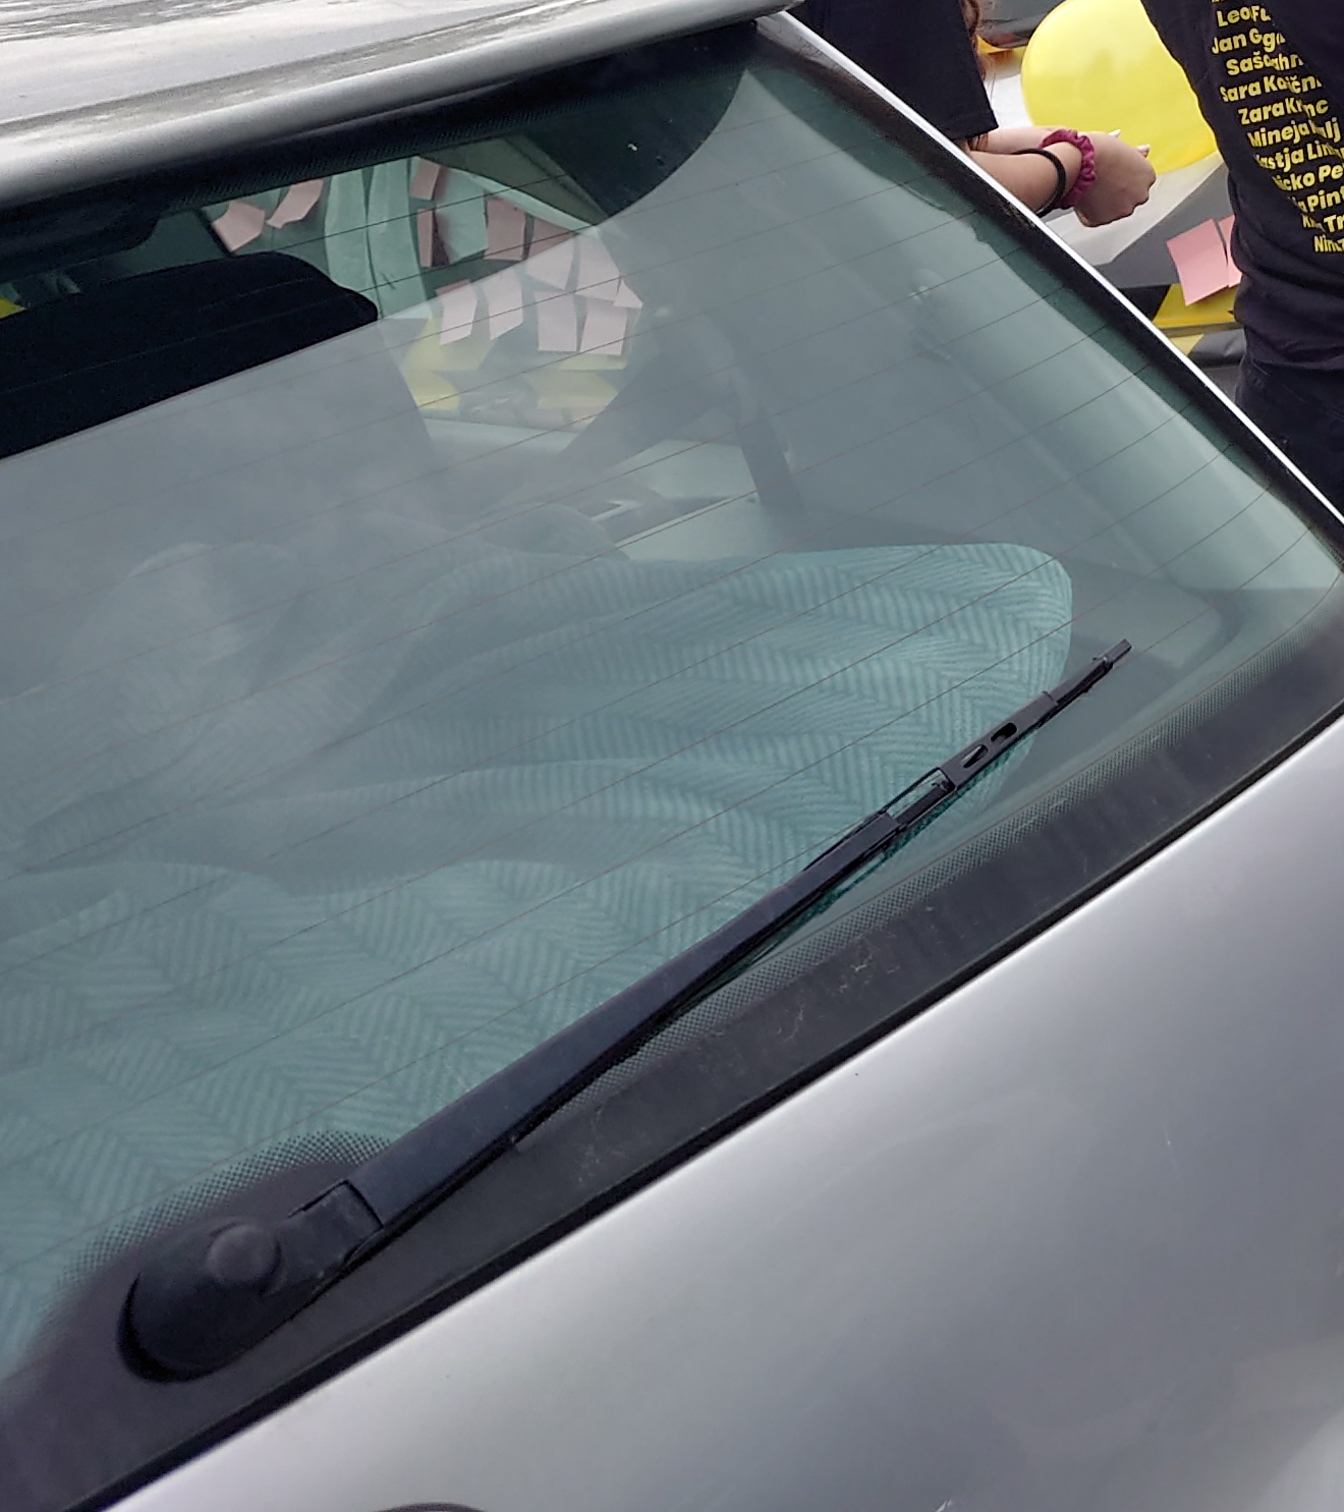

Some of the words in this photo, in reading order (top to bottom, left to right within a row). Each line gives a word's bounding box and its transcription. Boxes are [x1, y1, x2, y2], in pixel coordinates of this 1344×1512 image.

[1212, 33, 1247, 55] Jan
[1220, 81, 1262, 103] Sara
[1237, 101, 1285, 125] Zara
